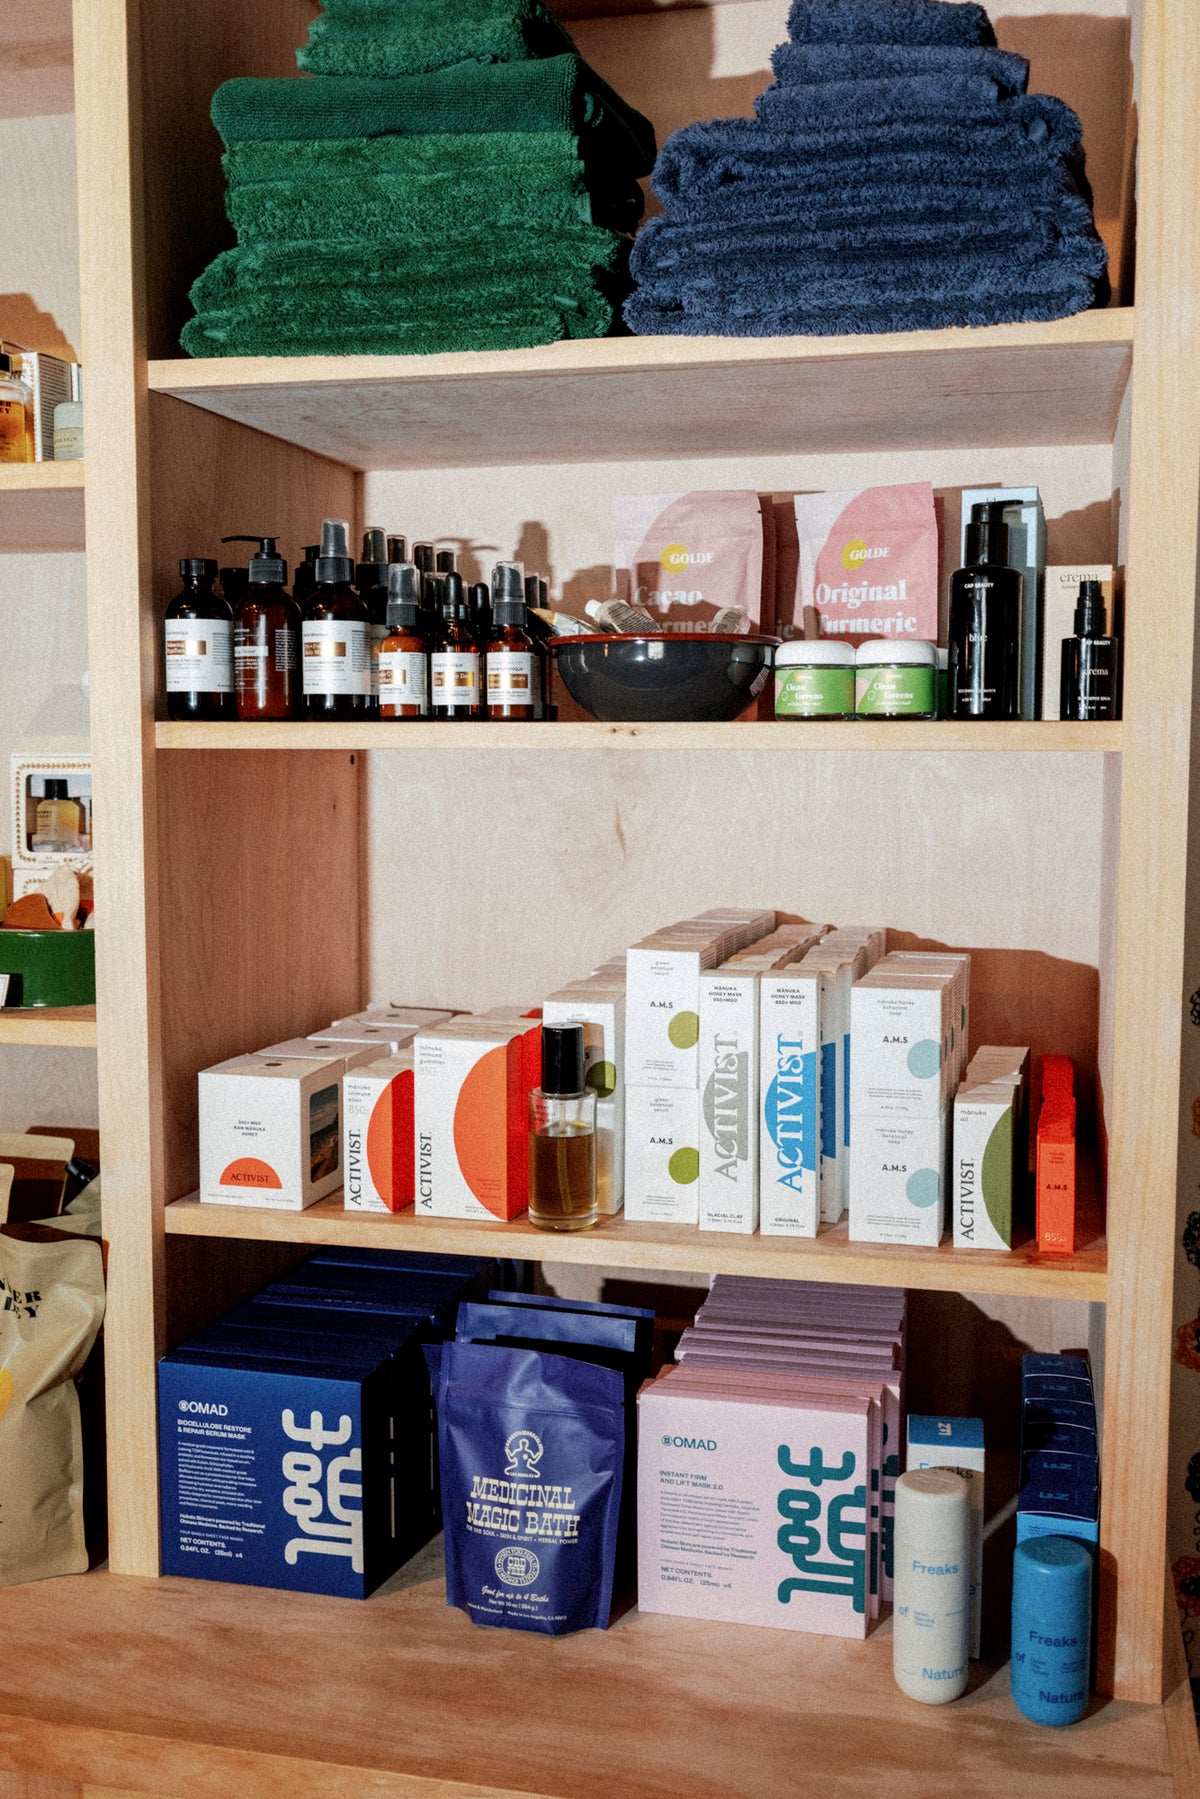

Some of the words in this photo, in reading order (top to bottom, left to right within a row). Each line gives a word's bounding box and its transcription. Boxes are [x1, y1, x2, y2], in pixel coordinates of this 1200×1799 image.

[669, 552, 713, 564] GOLDE
[849, 547, 891, 561] GOLDE
[816, 579, 906, 609] Original
[650, 1001, 673, 1009] A.M.S
[714, 1032, 739, 1183] ACTIVIST
[777, 1032, 804, 1194] ACTIVIST
[349, 1131, 362, 1206] ACTIVIST
[420, 1132, 432, 1209] ACTIVIST
[882, 1164, 907, 1172] A.M.S
[231, 1174, 269, 1183] ACTIVIST
[960, 1158, 974, 1241] ACTIVIST
[206, 1430, 227, 1438] SERUM
[224, 1425, 252, 1433] RESTORE
[660, 1470, 688, 1478] INSTANT
[470, 1475, 576, 1511] MEDICINAL
[466, 1501, 522, 1533] MAGIC
[525, 1507, 581, 1538] BATH
[483, 1529, 495, 1537] SOUL
[500, 1532, 512, 1540] SKIN
[508, 1557, 526, 1567] CBD
[911, 1560, 959, 1576] Freaks
[899, 1606, 909, 1618] of
[1029, 1630, 1078, 1647] Freaks
[1015, 1652, 1025, 1663] of
